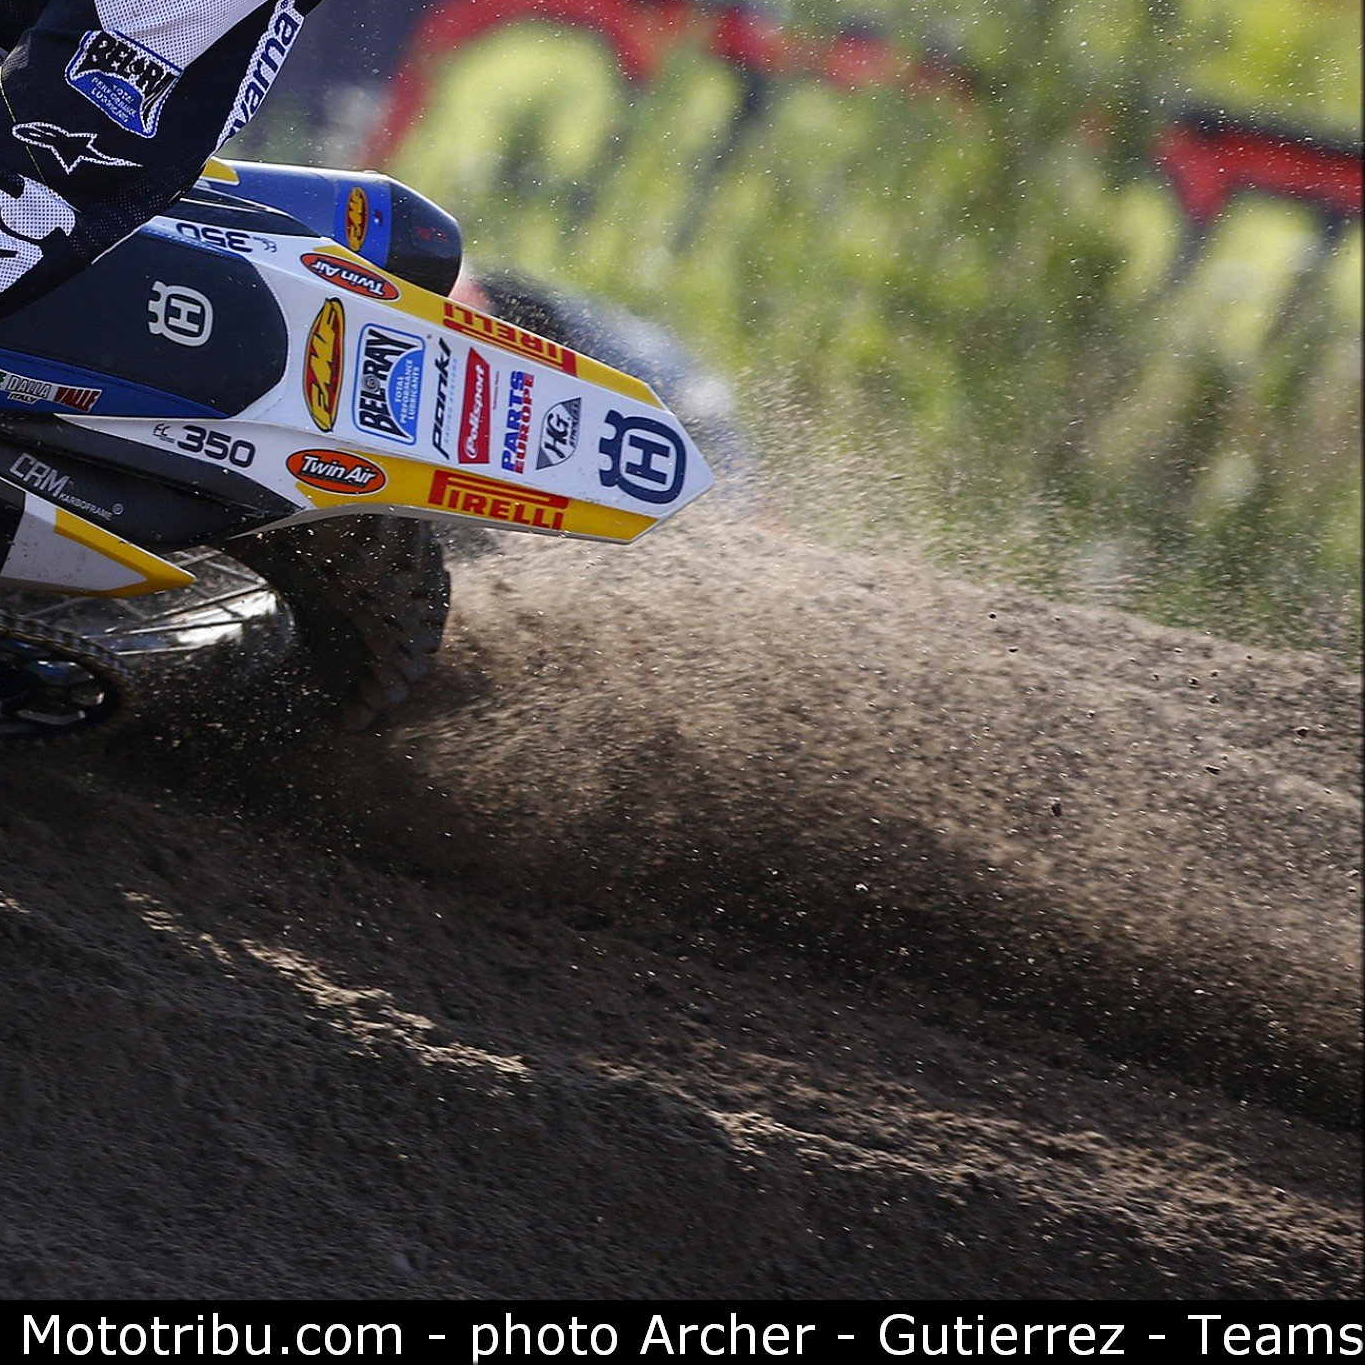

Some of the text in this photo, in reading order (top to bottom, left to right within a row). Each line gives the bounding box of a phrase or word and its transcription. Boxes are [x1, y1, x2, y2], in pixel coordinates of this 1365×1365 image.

[311, 260, 386, 297] Twin Air
[309, 299, 342, 432] FMF
[442, 301, 578, 378] PIRELLI
[6, 375, 52, 400] DALLA
[53, 386, 102, 413] VALLE
[8, 392, 40, 405] ITALY
[394, 375, 405, 403] TOTAL
[400, 358, 414, 425] PERFORMANCE
[464, 363, 486, 460] Polisport
[153, 422, 256, 469] FC 350
[501, 370, 527, 472] PARTS
[513, 372, 535, 475] EUROPE
[9, 451, 71, 499] CRM
[300, 454, 376, 486] Twin Air
[428, 469, 571, 532] PIRELLI
